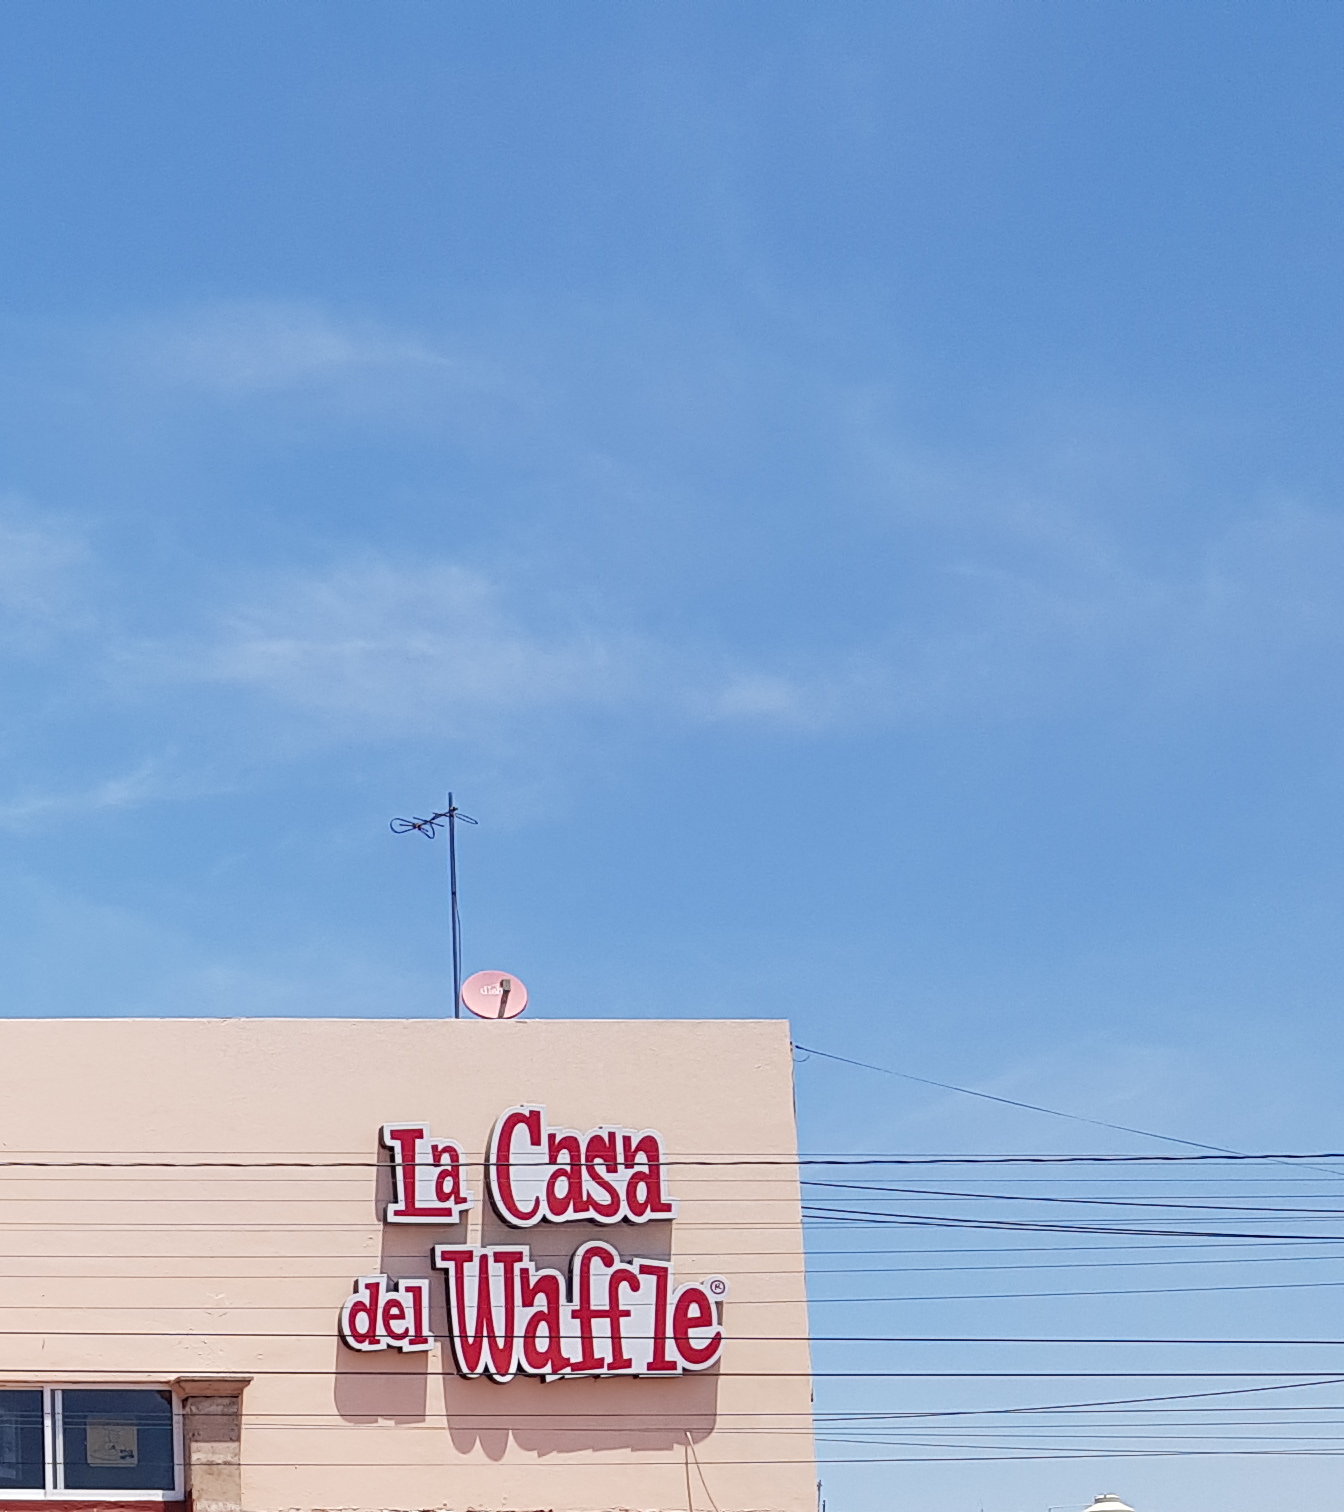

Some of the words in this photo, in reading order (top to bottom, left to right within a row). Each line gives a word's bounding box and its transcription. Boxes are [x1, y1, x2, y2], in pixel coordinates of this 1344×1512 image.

[388, 1127, 469, 1218] La
[495, 1109, 674, 1223] Casa
[347, 1281, 430, 1346] del
[440, 1245, 723, 1374] Waffle
